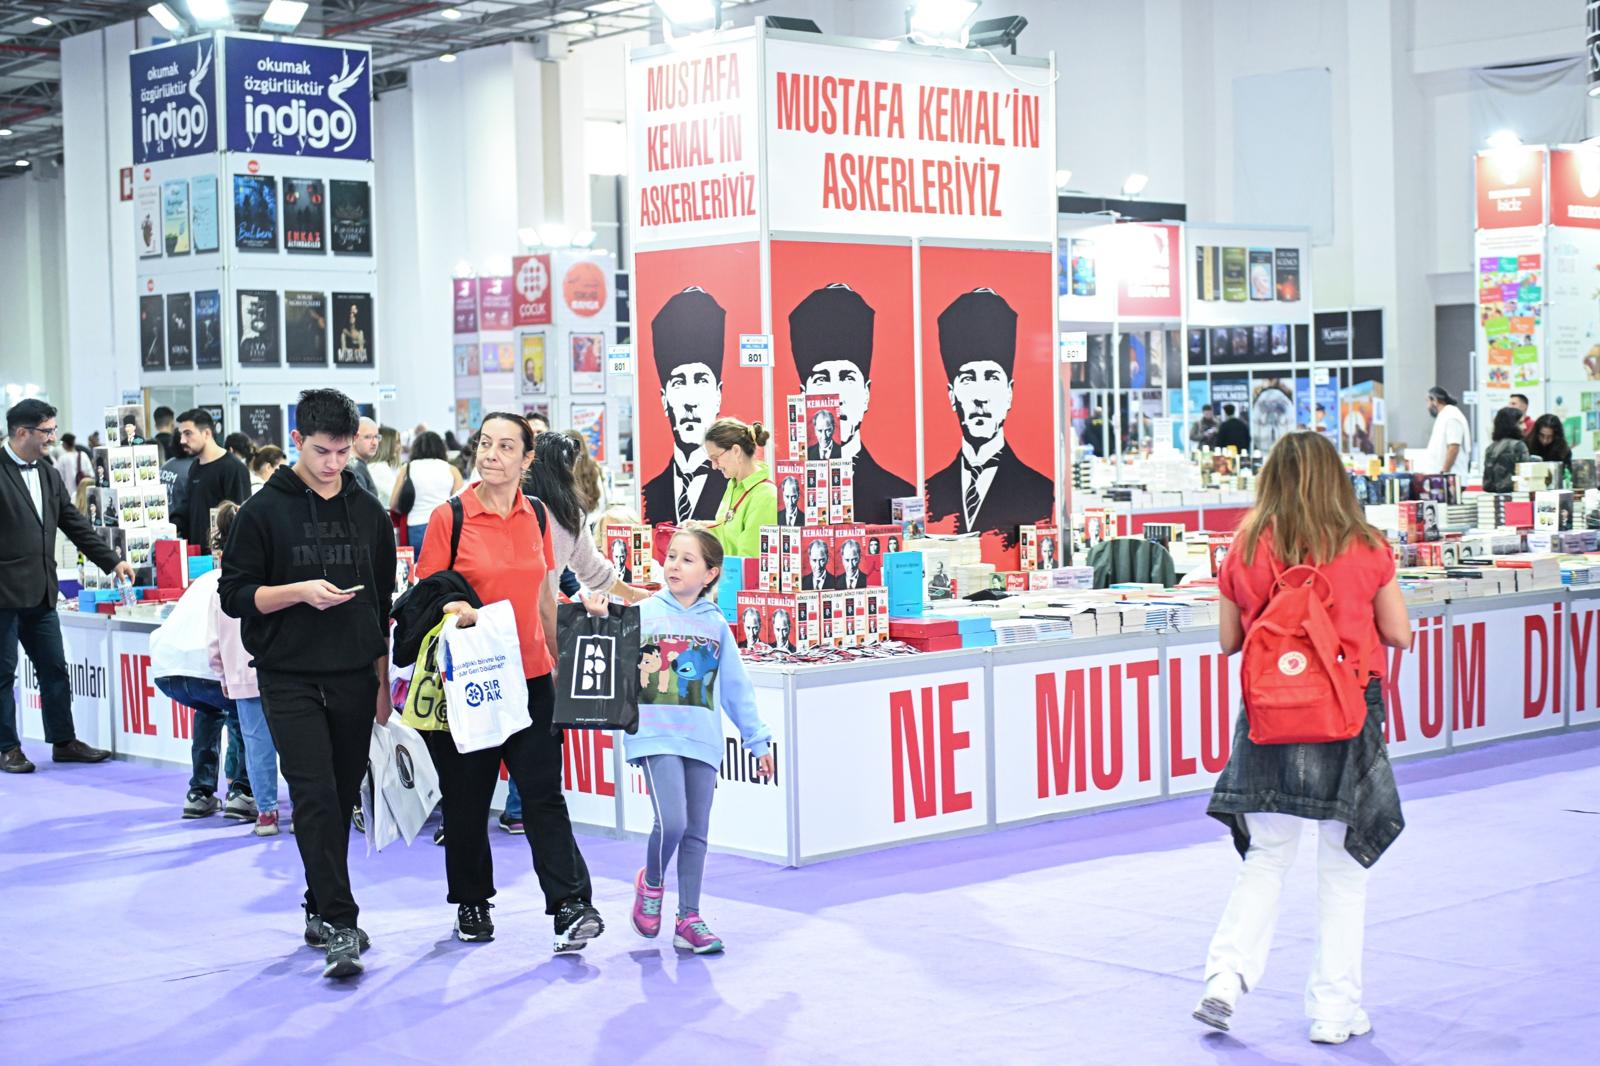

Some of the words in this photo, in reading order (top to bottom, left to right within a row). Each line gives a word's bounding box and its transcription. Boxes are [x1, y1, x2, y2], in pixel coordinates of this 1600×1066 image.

[141, 81, 187, 104] özgürlüktür
[147, 61, 179, 81] okumak
[244, 75, 325, 96] özgürlüktür
[257, 56, 311, 75] okumak
[647, 52, 741, 112] MUSTAFA
[141, 101, 205, 148] indigo
[245, 95, 352, 149] indigo
[776, 71, 905, 139] MUSTAFA
[918, 84, 1041, 148] KEMAL'İN
[647, 111, 742, 172] KEMAL'İN
[640, 170, 757, 227] ASKERLERİYİZ
[822, 152, 1003, 217] ASKERLERİYİZ
[614, 362, 626, 371] 801
[748, 353, 762, 363] 801
[806, 397, 840, 408] KEMALİZM
[120, 653, 158, 736] NE
[889, 681, 973, 824] NE
[1034, 653, 1230, 799] MUTLU
